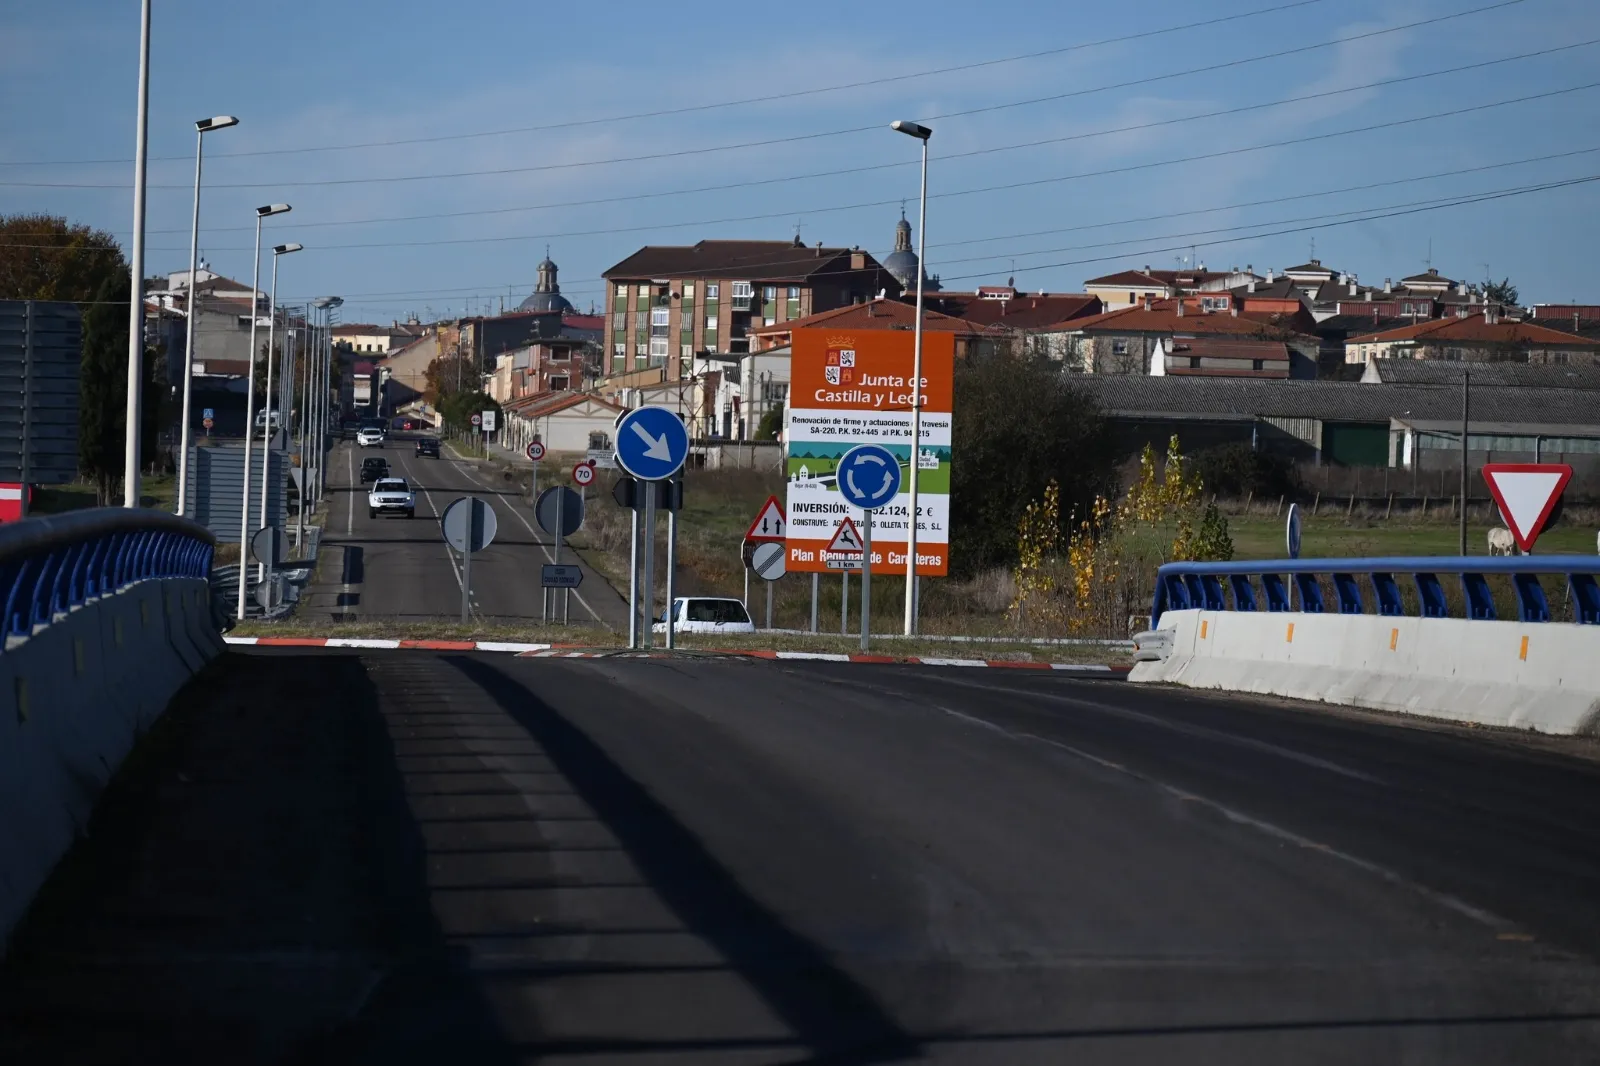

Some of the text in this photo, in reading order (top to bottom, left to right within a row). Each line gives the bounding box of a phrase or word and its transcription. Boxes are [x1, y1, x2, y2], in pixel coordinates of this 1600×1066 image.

[858, 373, 903, 387] Junta
[814, 388, 871, 403] Castilla
[873, 393, 884, 407] y
[792, 416, 831, 425] Renovación
[832, 417, 841, 425] de
[843, 417, 861, 426] firme
[863, 419, 868, 427] y
[868, 418, 909, 427] actuaciones
[810, 426, 837, 435] SA-220.
[838, 427, 850, 435] P.K.
[852, 428, 878, 436] 92+445
[890, 429, 902, 437] P.K.
[904, 429, 930, 438] 94215
[578, 470, 590, 478] 70
[792, 502, 850, 514] INVERSIÓN:
[926, 507, 933, 517] €
[792, 518, 829, 527] CONSTRUYE:
[880, 521, 902, 529] OLLETA
[931, 523, 943, 531] S.L.
[791, 549, 814, 562] Plan
[869, 551, 882, 563] de
